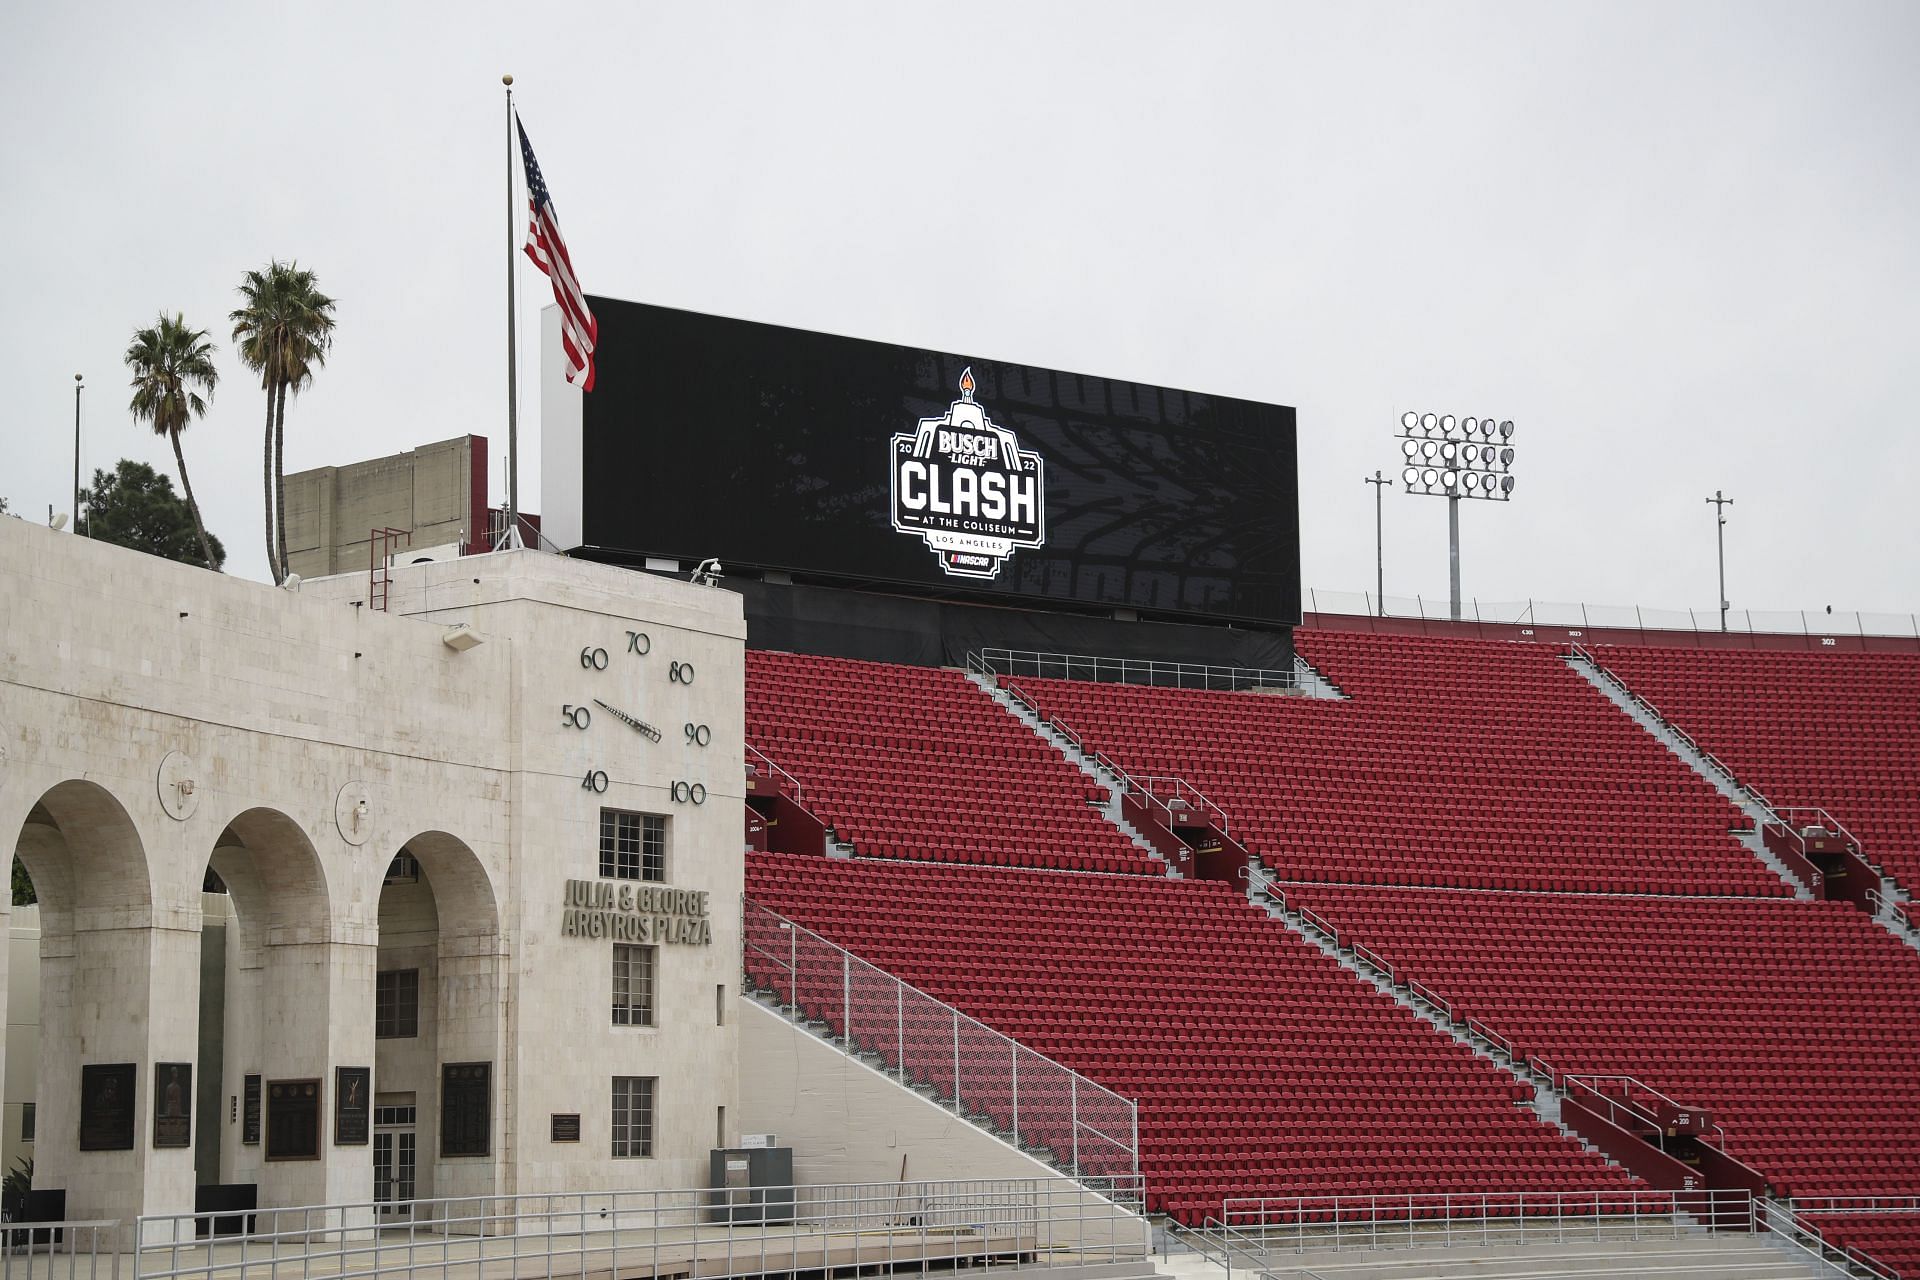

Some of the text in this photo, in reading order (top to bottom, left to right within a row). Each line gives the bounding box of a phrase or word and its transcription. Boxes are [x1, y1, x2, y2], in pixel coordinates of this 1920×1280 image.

[899, 443, 912, 454] 20
[938, 430, 998, 460] BUSCH
[1023, 461, 1035, 471] 22
[901, 460, 1035, 524] CLASH
[922, 516, 1016, 535] AT THE COLISEUM
[936, 535, 1003, 550] LOS ANGELES
[959, 554, 990, 567] NASCAR
[625, 630, 651, 655] 70
[1821, 638, 1836, 646] 302
[580, 646, 609, 671] 60
[669, 660, 695, 685] 80
[562, 704, 591, 730] 50
[684, 722, 711, 747] 90
[582, 769, 609, 793] 40
[670, 780, 707, 805] 100
[564, 879, 710, 916] JULIA & GEORGE
[561, 909, 713, 945] ARGYROS PLAZA
